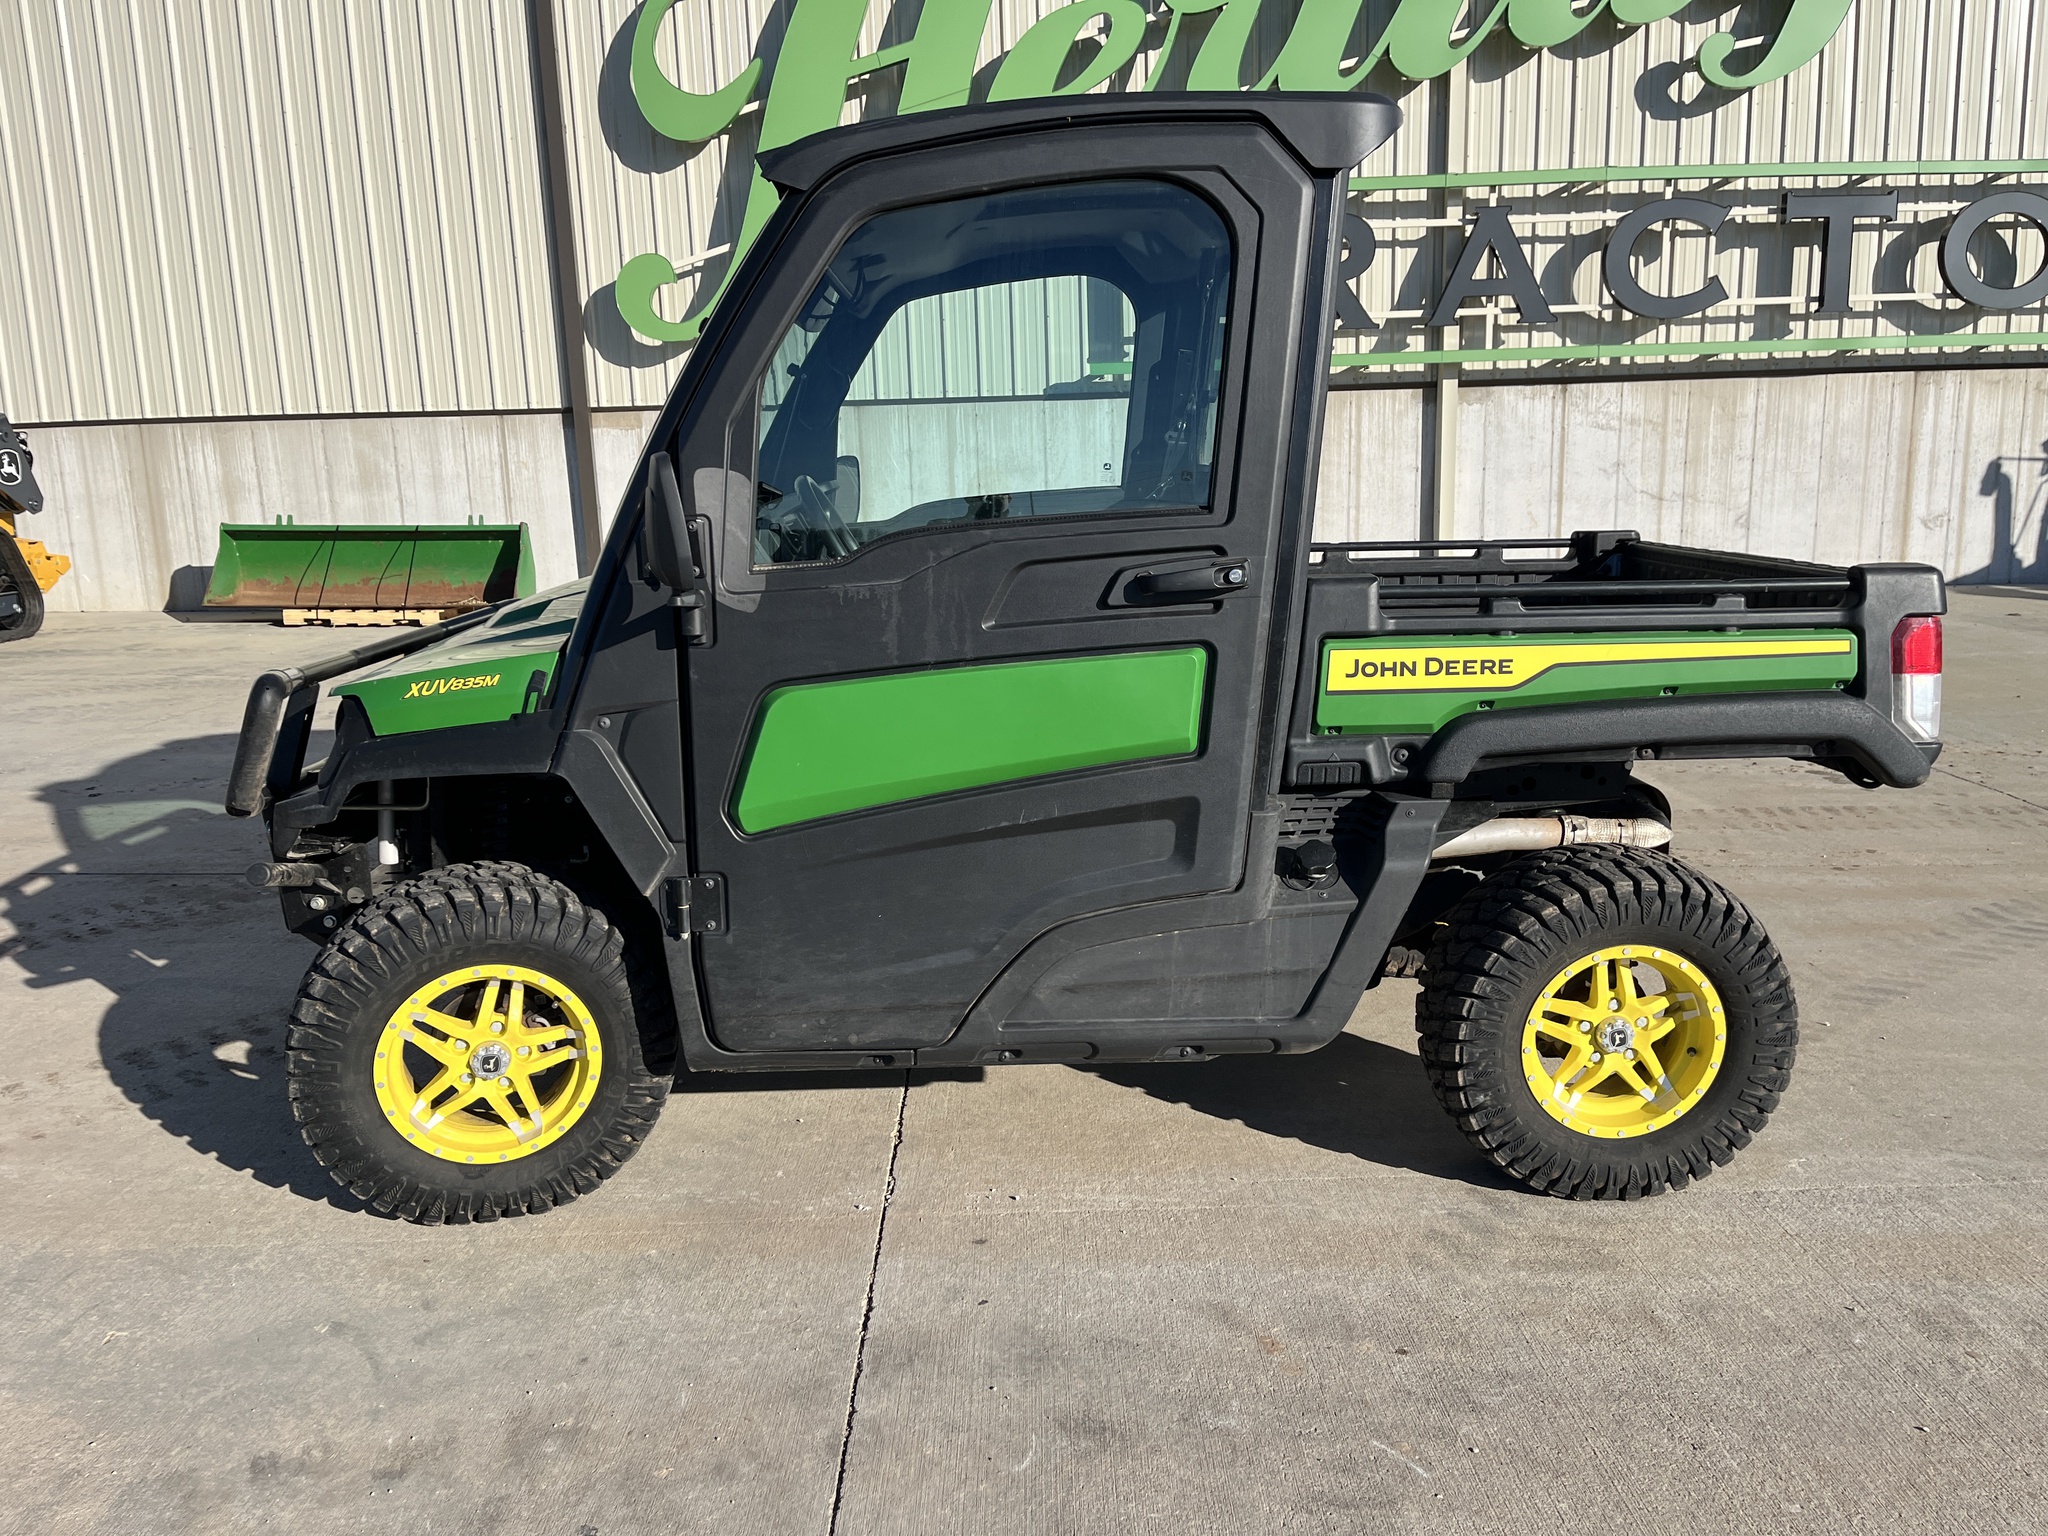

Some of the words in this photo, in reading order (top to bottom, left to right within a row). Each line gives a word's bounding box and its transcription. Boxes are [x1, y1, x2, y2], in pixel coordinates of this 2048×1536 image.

[1345, 658, 1417, 678] JOHN
[1424, 657, 1514, 676] DEERE
[402, 673, 501, 699] XUV835M
